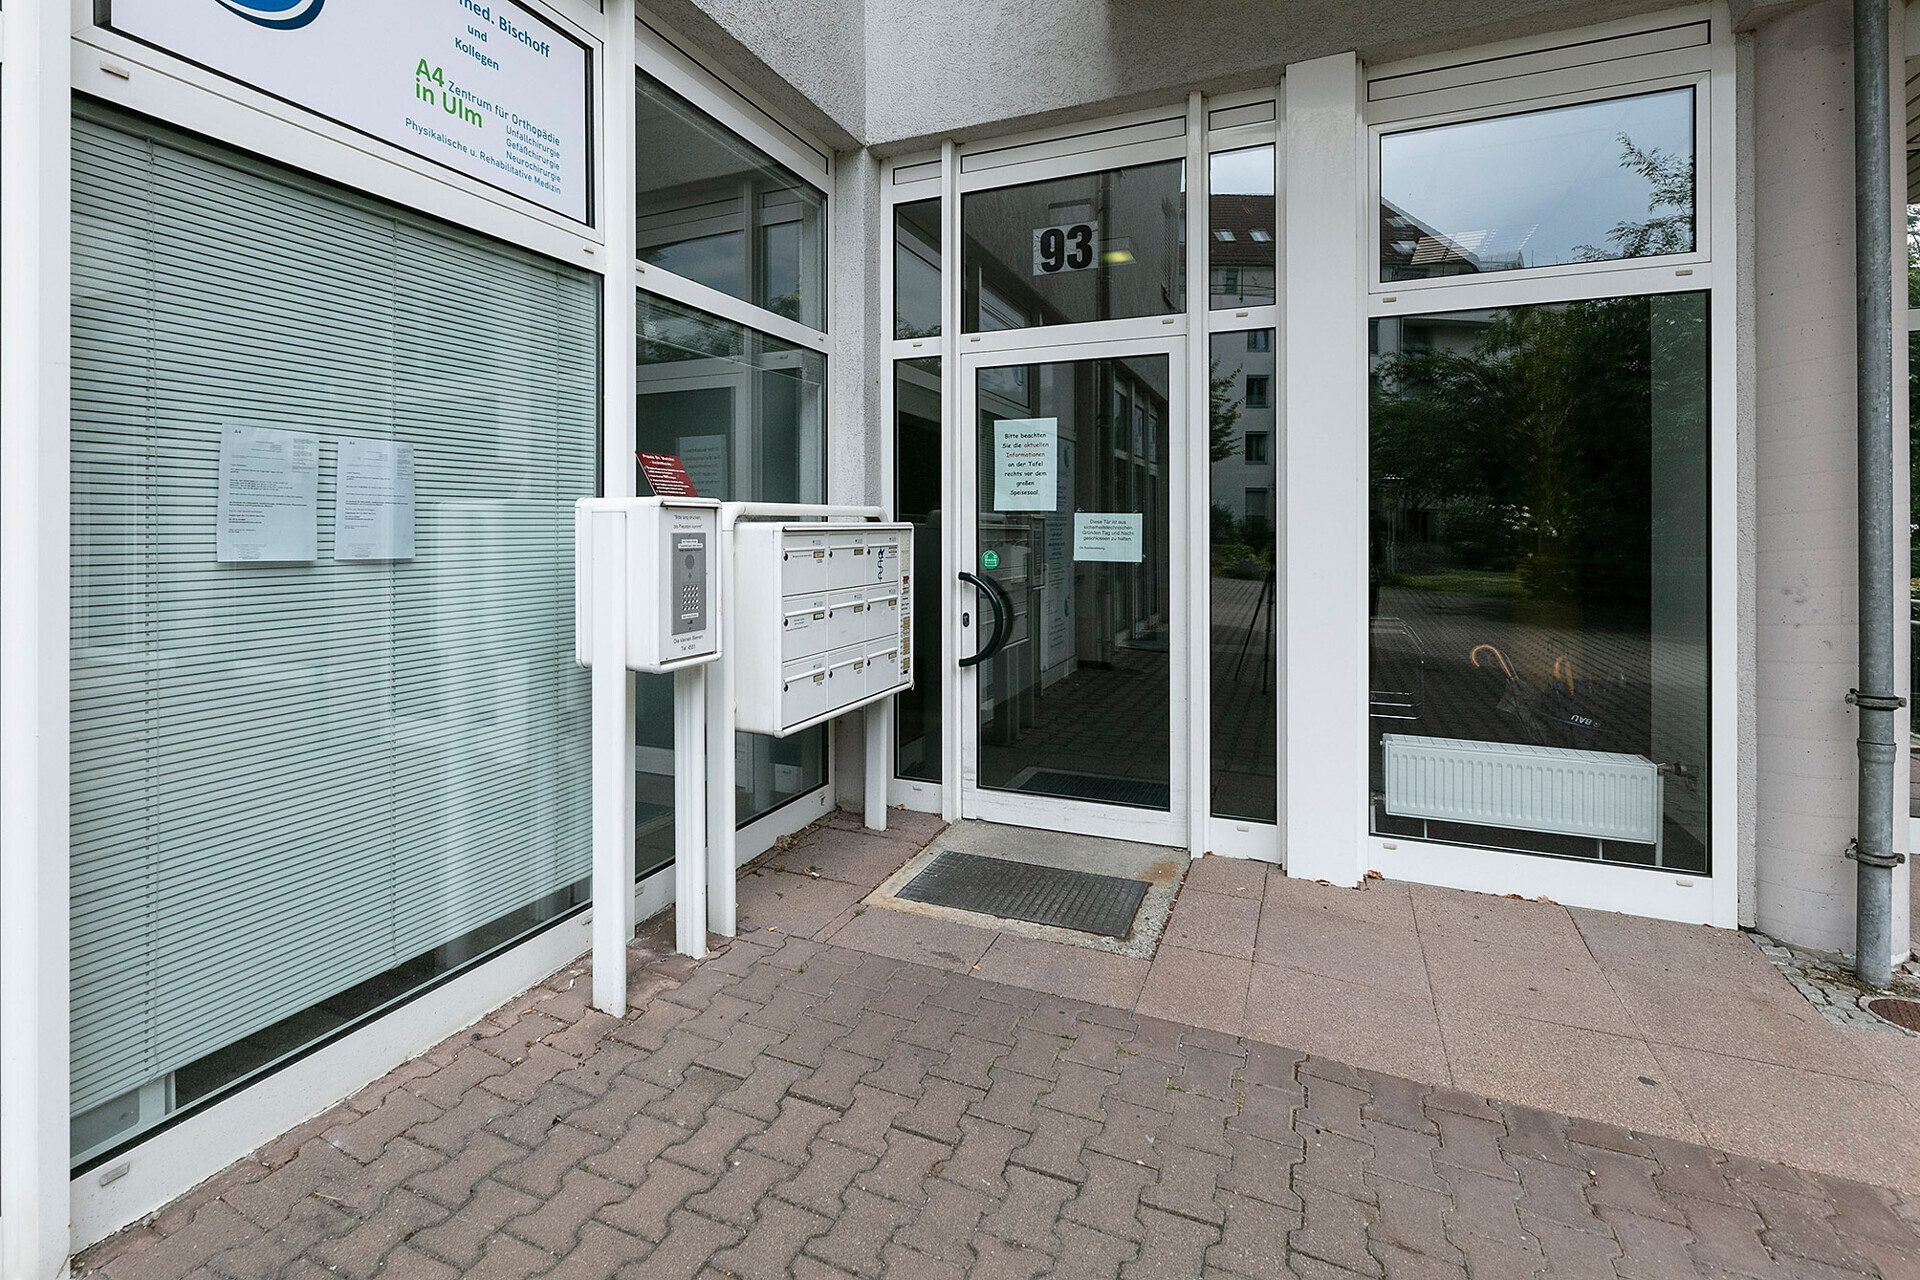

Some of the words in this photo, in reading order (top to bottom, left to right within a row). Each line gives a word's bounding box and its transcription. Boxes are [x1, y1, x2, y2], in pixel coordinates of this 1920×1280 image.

[467, 25, 488, 43] und
[499, 15, 551, 58] Bischoff
[454, 37, 500, 71] Kollegen
[415, 58, 445, 88] A4
[415, 77, 435, 106] in
[442, 91, 483, 129] Ulm
[448, 80, 493, 112] Zentrum
[494, 104, 510, 120] für
[511, 113, 560, 146] Orthopädie
[405, 117, 468, 154] Physikalische
[469, 147, 478, 158] u.
[479, 150, 533, 182] Rehabilitative
[533, 175, 561, 195] Medizin
[506, 125, 560, 159] Unfallchirurgie
[506, 138, 560, 171] Gefäßchirurgie
[506, 150, 561, 183] Neurochirurgie
[1040, 224, 1093, 273] 93
[1004, 432, 1019, 440] Bitte
[1023, 441, 1050, 449] aktuellen
[1016, 480, 1035, 488] großen
